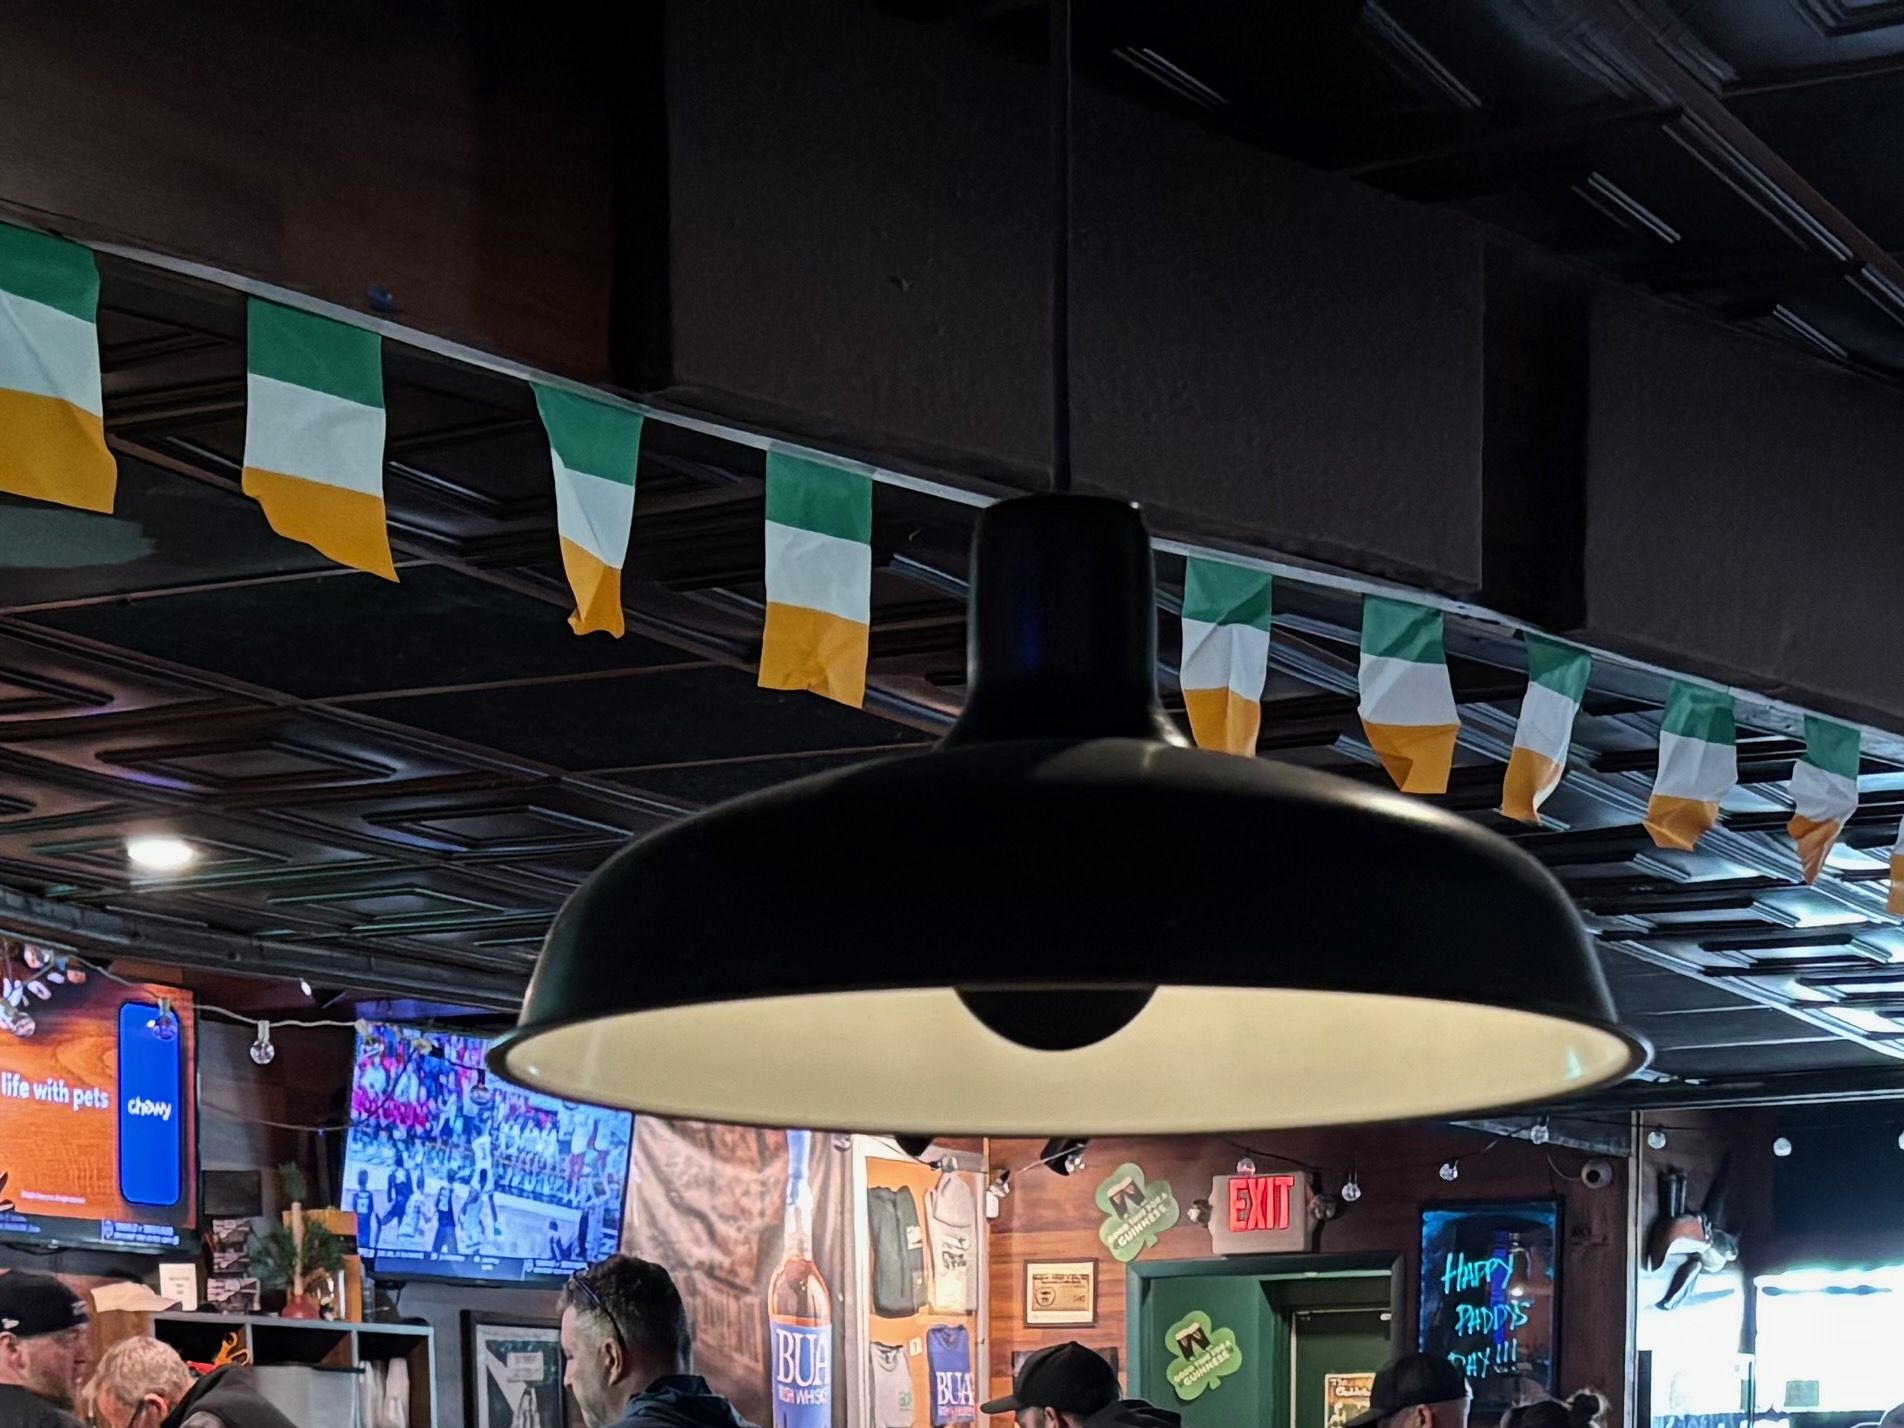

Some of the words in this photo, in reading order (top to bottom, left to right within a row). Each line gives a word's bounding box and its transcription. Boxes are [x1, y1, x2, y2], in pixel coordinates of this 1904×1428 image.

[1, 1072, 31, 1099] life
[32, 1078, 70, 1104] with
[72, 1086, 110, 1112] pets
[1117, 1203, 1169, 1247] GUINNESS
[1229, 1175, 1295, 1232] EXIT
[1440, 1251, 1514, 1295] HAPPY
[776, 1328, 831, 1388] BUA
[1183, 1350, 1231, 1386] GUINNESS
[936, 1371, 974, 1406] BUA
